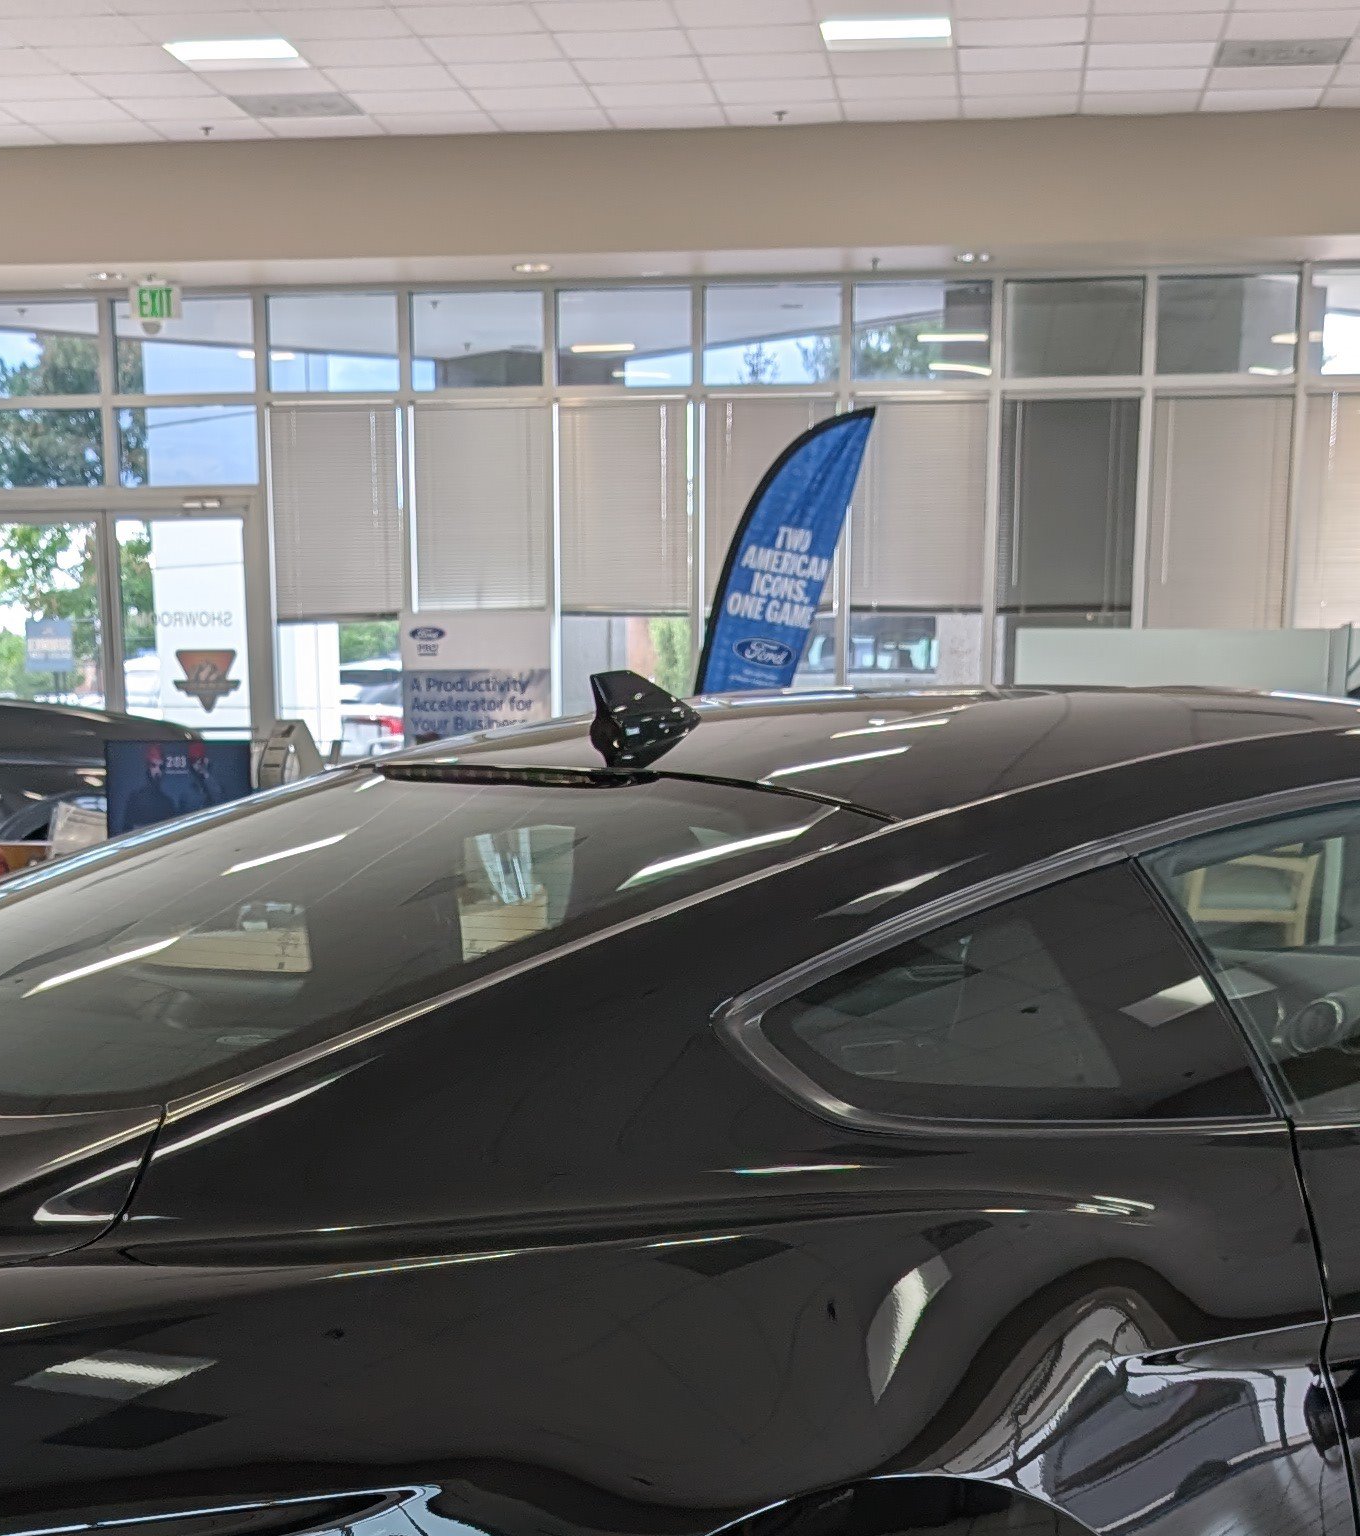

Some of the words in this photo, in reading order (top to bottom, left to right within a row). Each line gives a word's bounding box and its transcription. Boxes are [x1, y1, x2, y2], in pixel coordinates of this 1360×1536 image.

[138, 287, 173, 319] EXIT
[775, 525, 813, 552] TWO
[742, 545, 829, 581] AMERICAN
[751, 572, 810, 604] ICONS.
[727, 592, 767, 621] ONE
[765, 600, 815, 629] GAME
[743, 640, 790, 666] Ford
[410, 677, 422, 692] A
[425, 676, 530, 695] Productivity
[411, 697, 504, 713] Accelerator
[510, 696, 533, 711] for
[411, 717, 449, 732] Your
